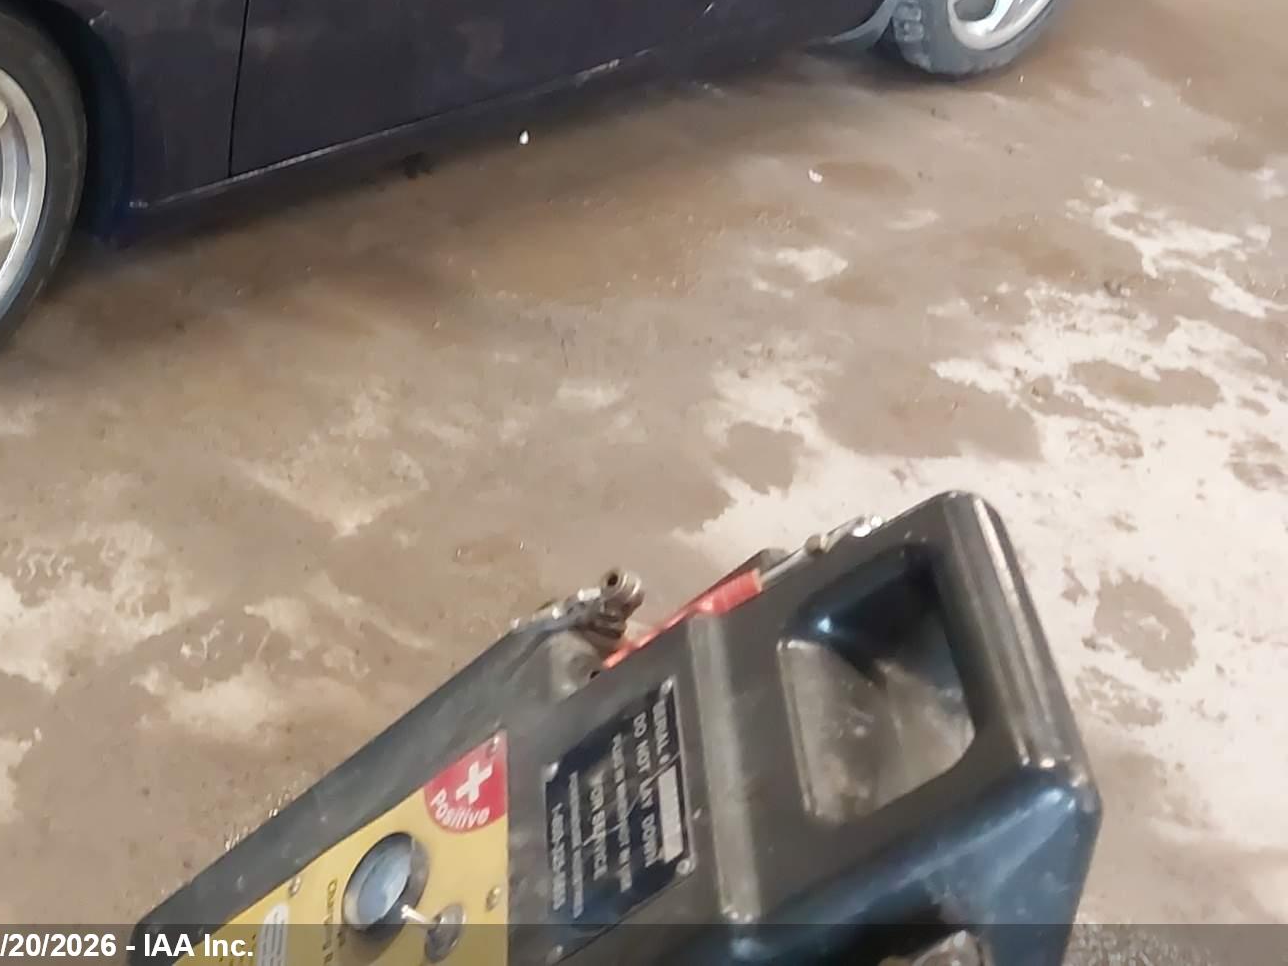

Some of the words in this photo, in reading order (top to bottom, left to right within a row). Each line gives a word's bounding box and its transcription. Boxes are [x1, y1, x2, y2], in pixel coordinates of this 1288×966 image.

[632, 711, 647, 739] DO
[635, 739, 651, 774] NOT
[430, 788, 490, 829] Positive
